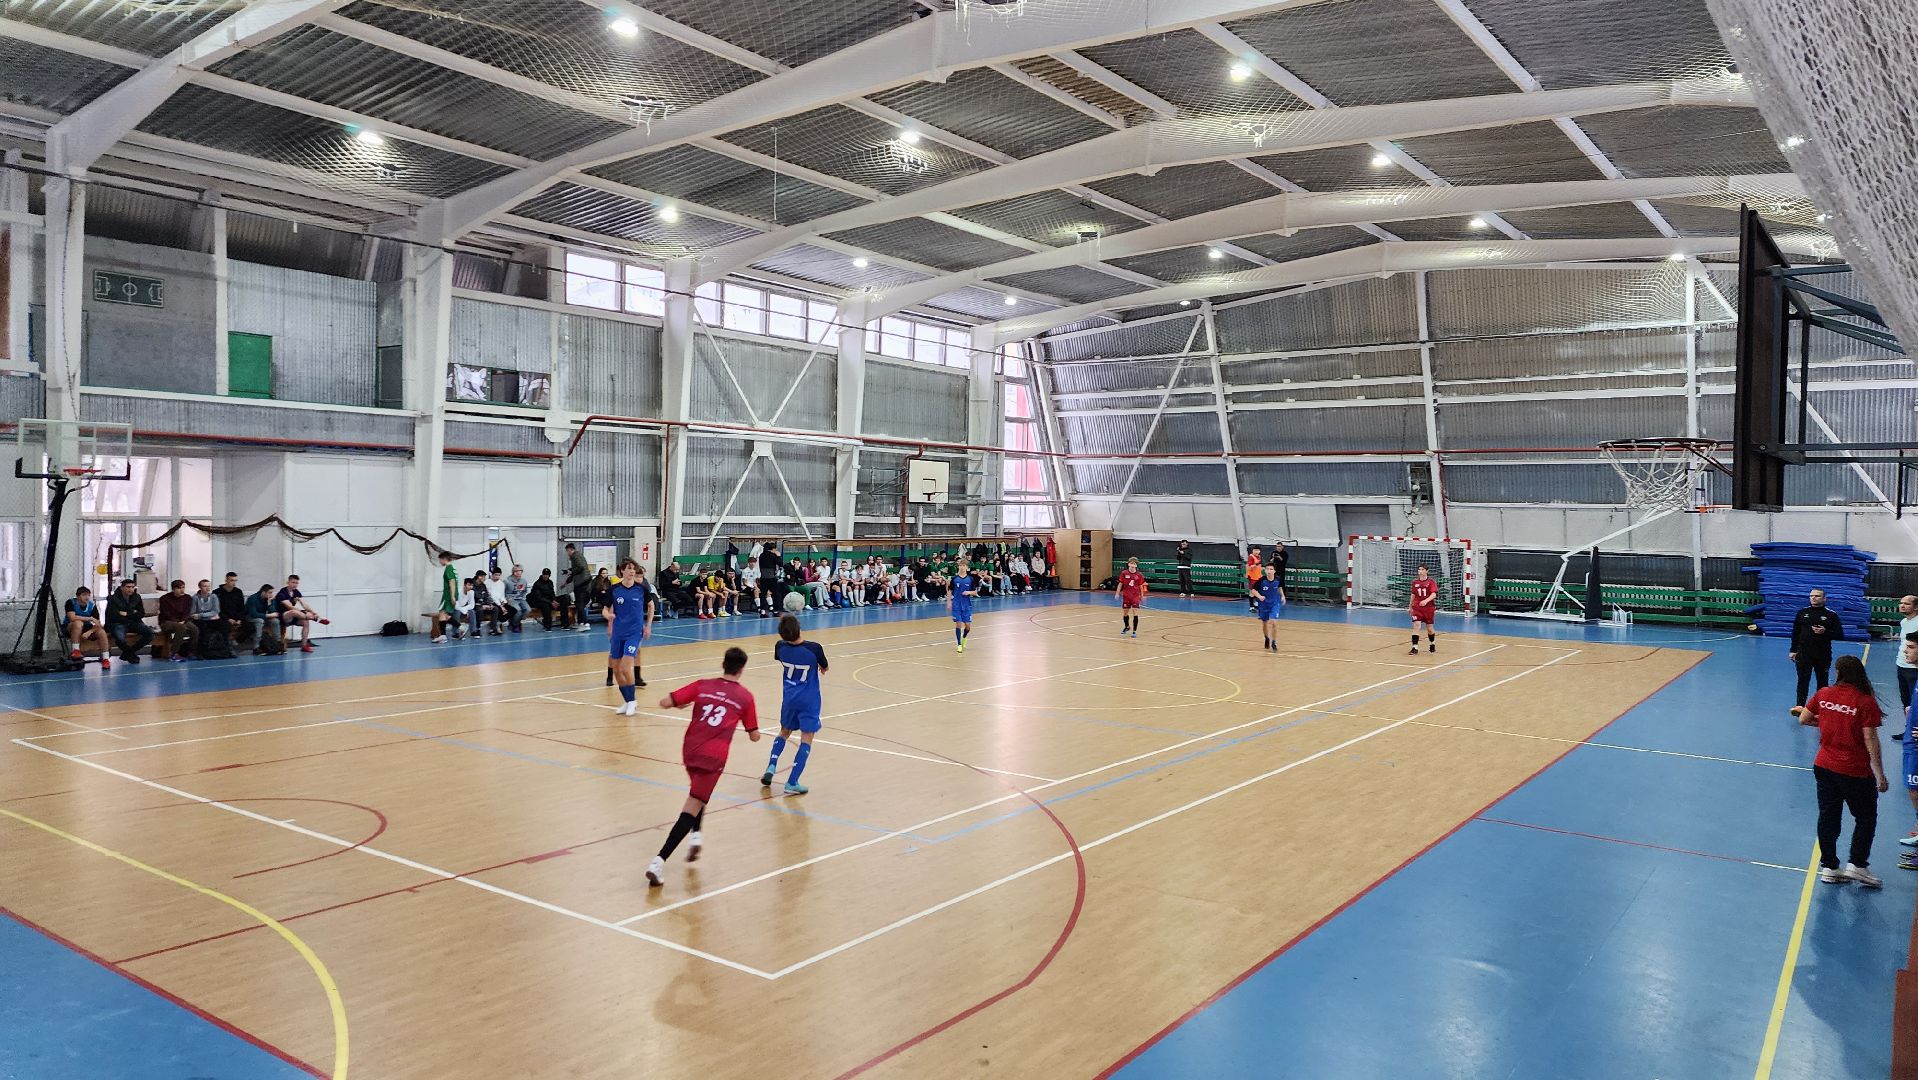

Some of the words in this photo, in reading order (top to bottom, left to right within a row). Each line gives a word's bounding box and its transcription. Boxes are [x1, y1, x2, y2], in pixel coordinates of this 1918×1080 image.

[1417, 588, 1427, 597] 11
[782, 661, 811, 682] 77
[700, 703, 728, 727] 13
[1819, 700, 1858, 716] COACH
